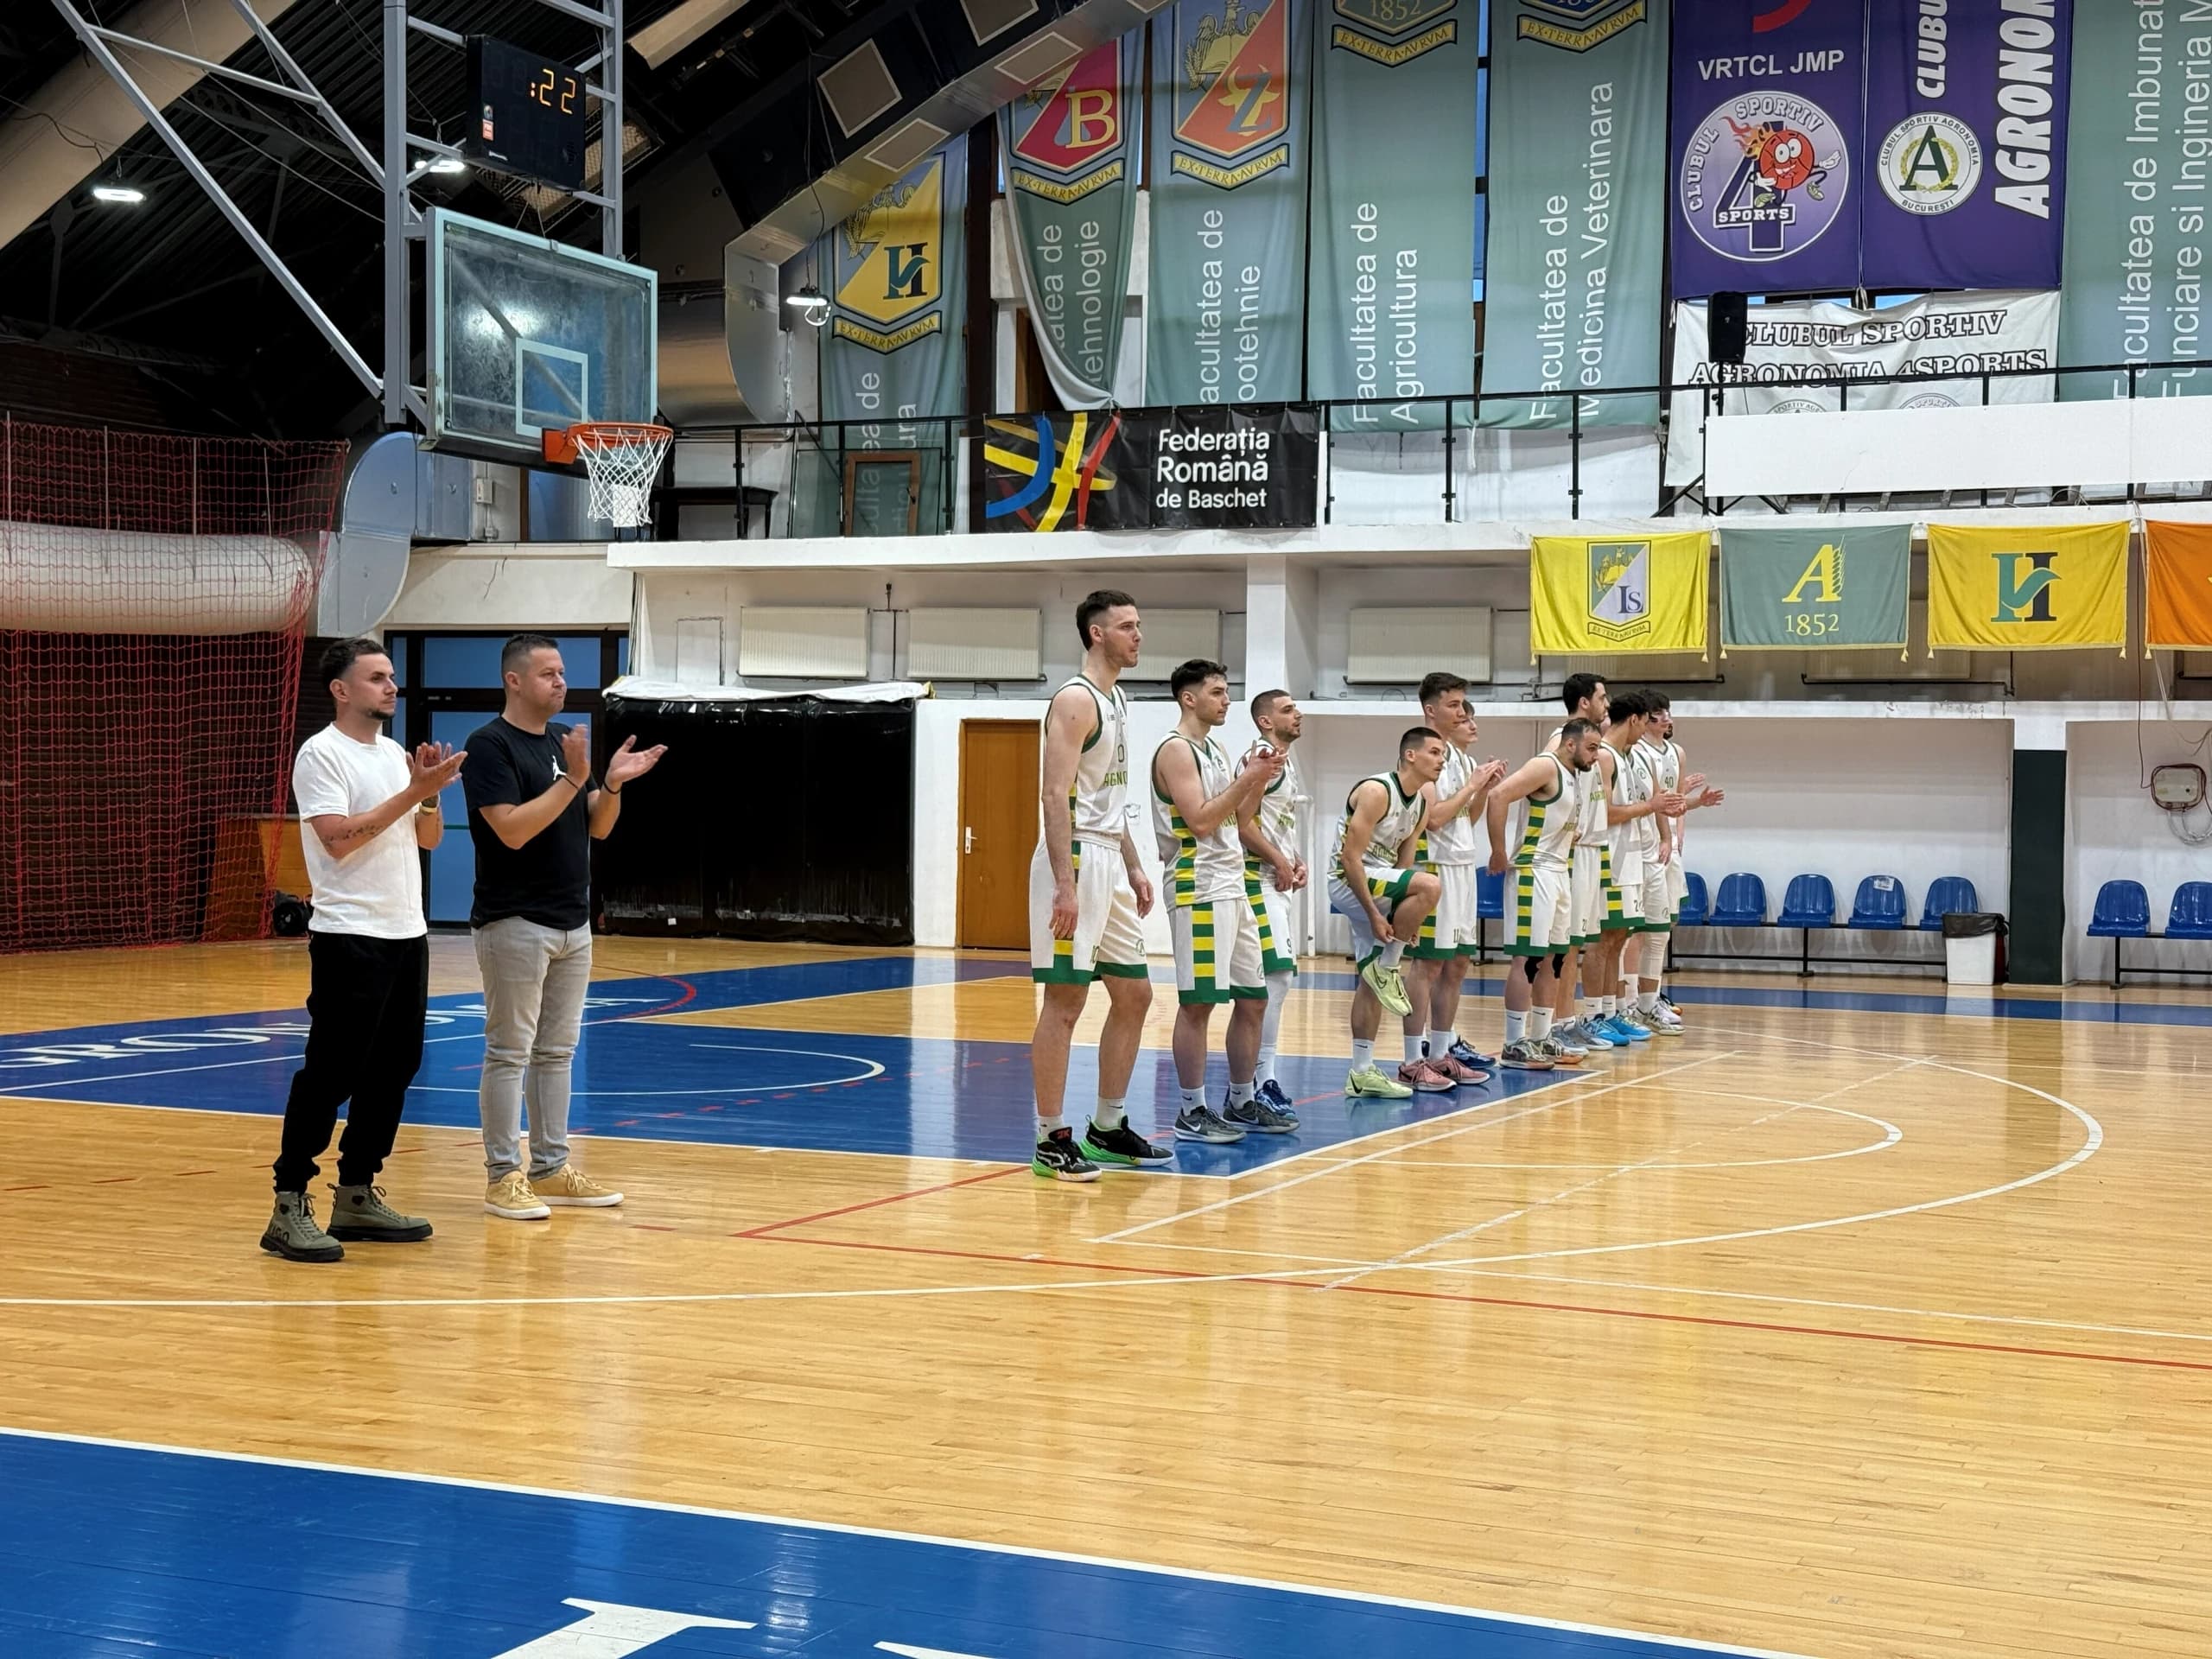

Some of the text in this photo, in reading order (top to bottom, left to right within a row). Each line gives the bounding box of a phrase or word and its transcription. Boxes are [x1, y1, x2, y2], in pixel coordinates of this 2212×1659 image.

[1371, 0, 1421, 21] 1852
[1698, 49, 1845, 80] VRTCL JMP
[2172, 35, 2212, 190] Ingineria
[1687, 96, 1825, 213] CLUBUL SPORTIV
[1881, 116, 1980, 166] CLUBUL SPORTIV AGRONOMIA
[1580, 82, 1614, 259] Veterinara
[2123, 157, 2158, 201] de
[1197, 209, 1224, 249] de
[1718, 208, 1790, 224] SPORTS
[2171, 206, 2204, 233] si
[1037, 224, 1063, 263] de
[1350, 202, 1379, 423] Facultatea de
[1529, 195, 1568, 420] Facultatea de
[1389, 249, 1425, 424] Agricultura
[1861, 309, 2007, 345] SPORTIV
[1688, 349, 2047, 387] AGRONOMIA 4SPORTS
[855, 372, 880, 410] de
[1159, 427, 1270, 456] Federația
[1156, 454, 1268, 484] Română
[1155, 488, 1268, 509] de Baschet
[1784, 613, 1840, 637] 1852
